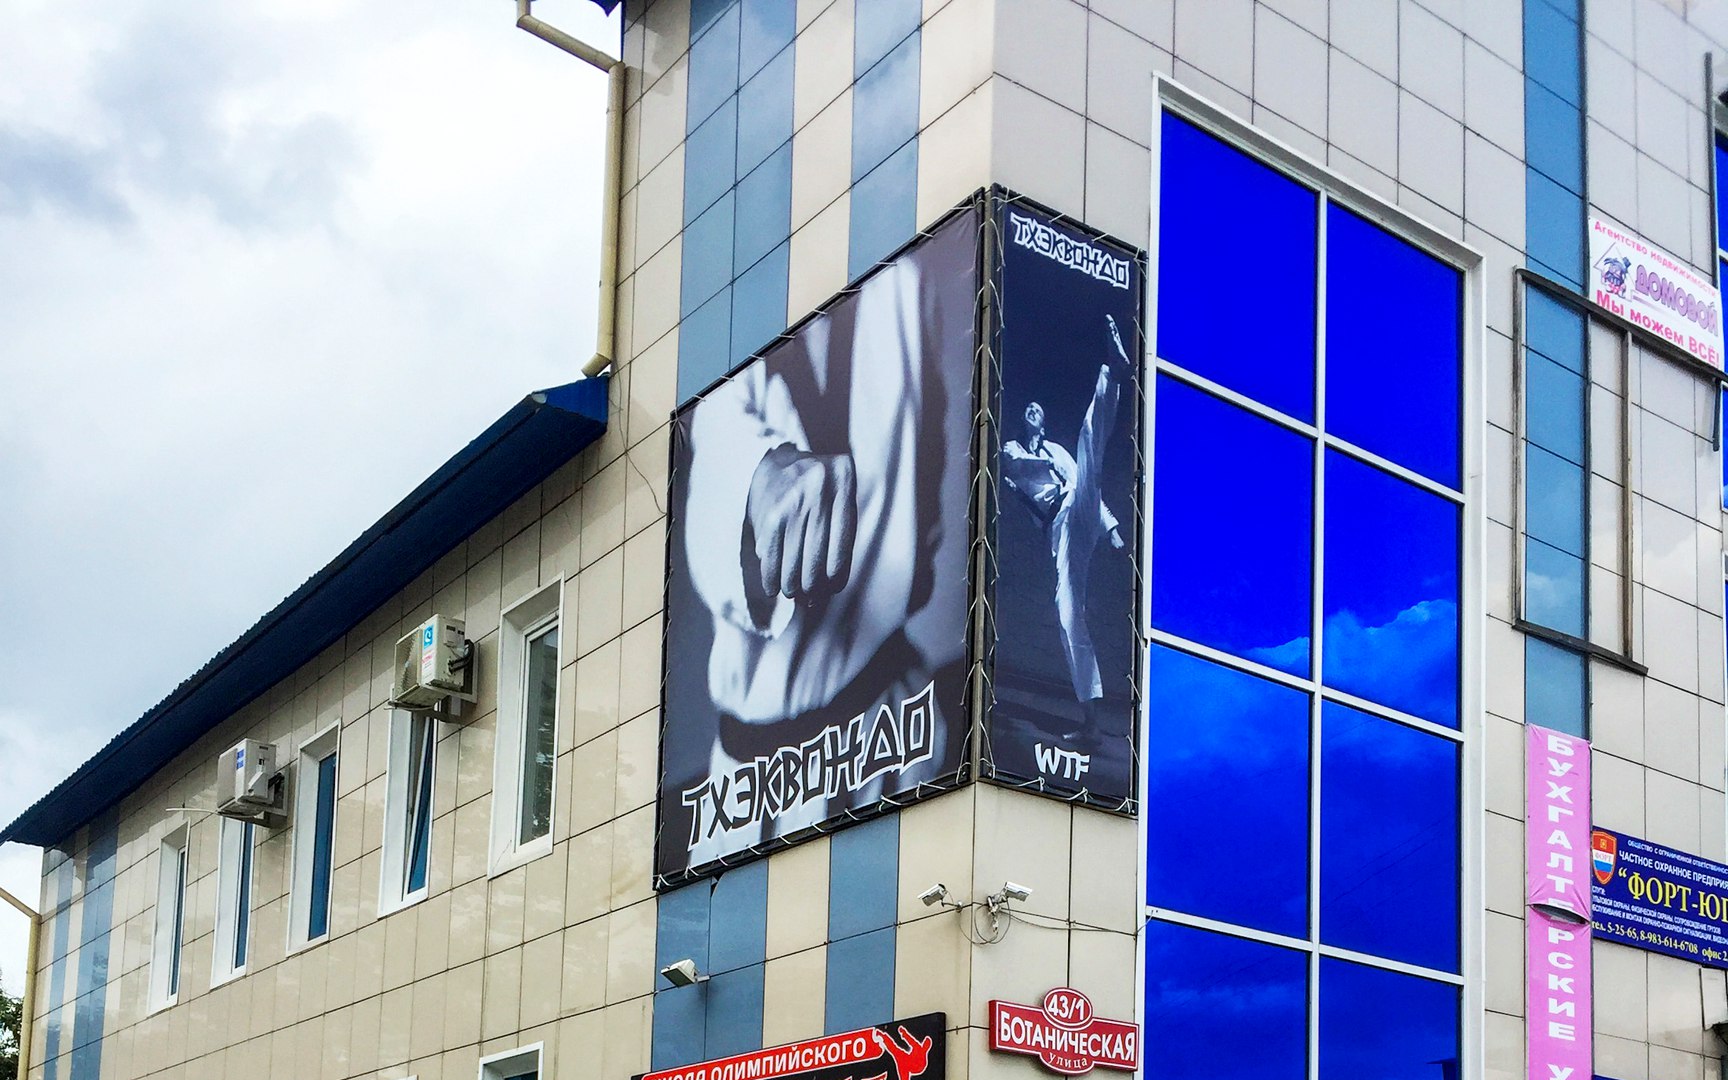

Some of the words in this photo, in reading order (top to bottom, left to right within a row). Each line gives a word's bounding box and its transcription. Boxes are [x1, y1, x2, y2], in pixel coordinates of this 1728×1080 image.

[1010, 212, 1130, 290] ТХЭКВОНДО
[1596, 289, 1625, 317] Мы
[1630, 308, 1685, 346] можем
[681, 679, 935, 852] ТХЭКВОНДО
[1034, 742, 1091, 782] WTF
[1618, 850, 1653, 869] ЧАСТНОЕ
[1654, 860, 1692, 880] ОХРАННОЕ
[1048, 994, 1085, 1021] 43/1
[1000, 1010, 1135, 1062] БОТАНИЧЕСКАЯ
[1049, 1052, 1088, 1069] улица
